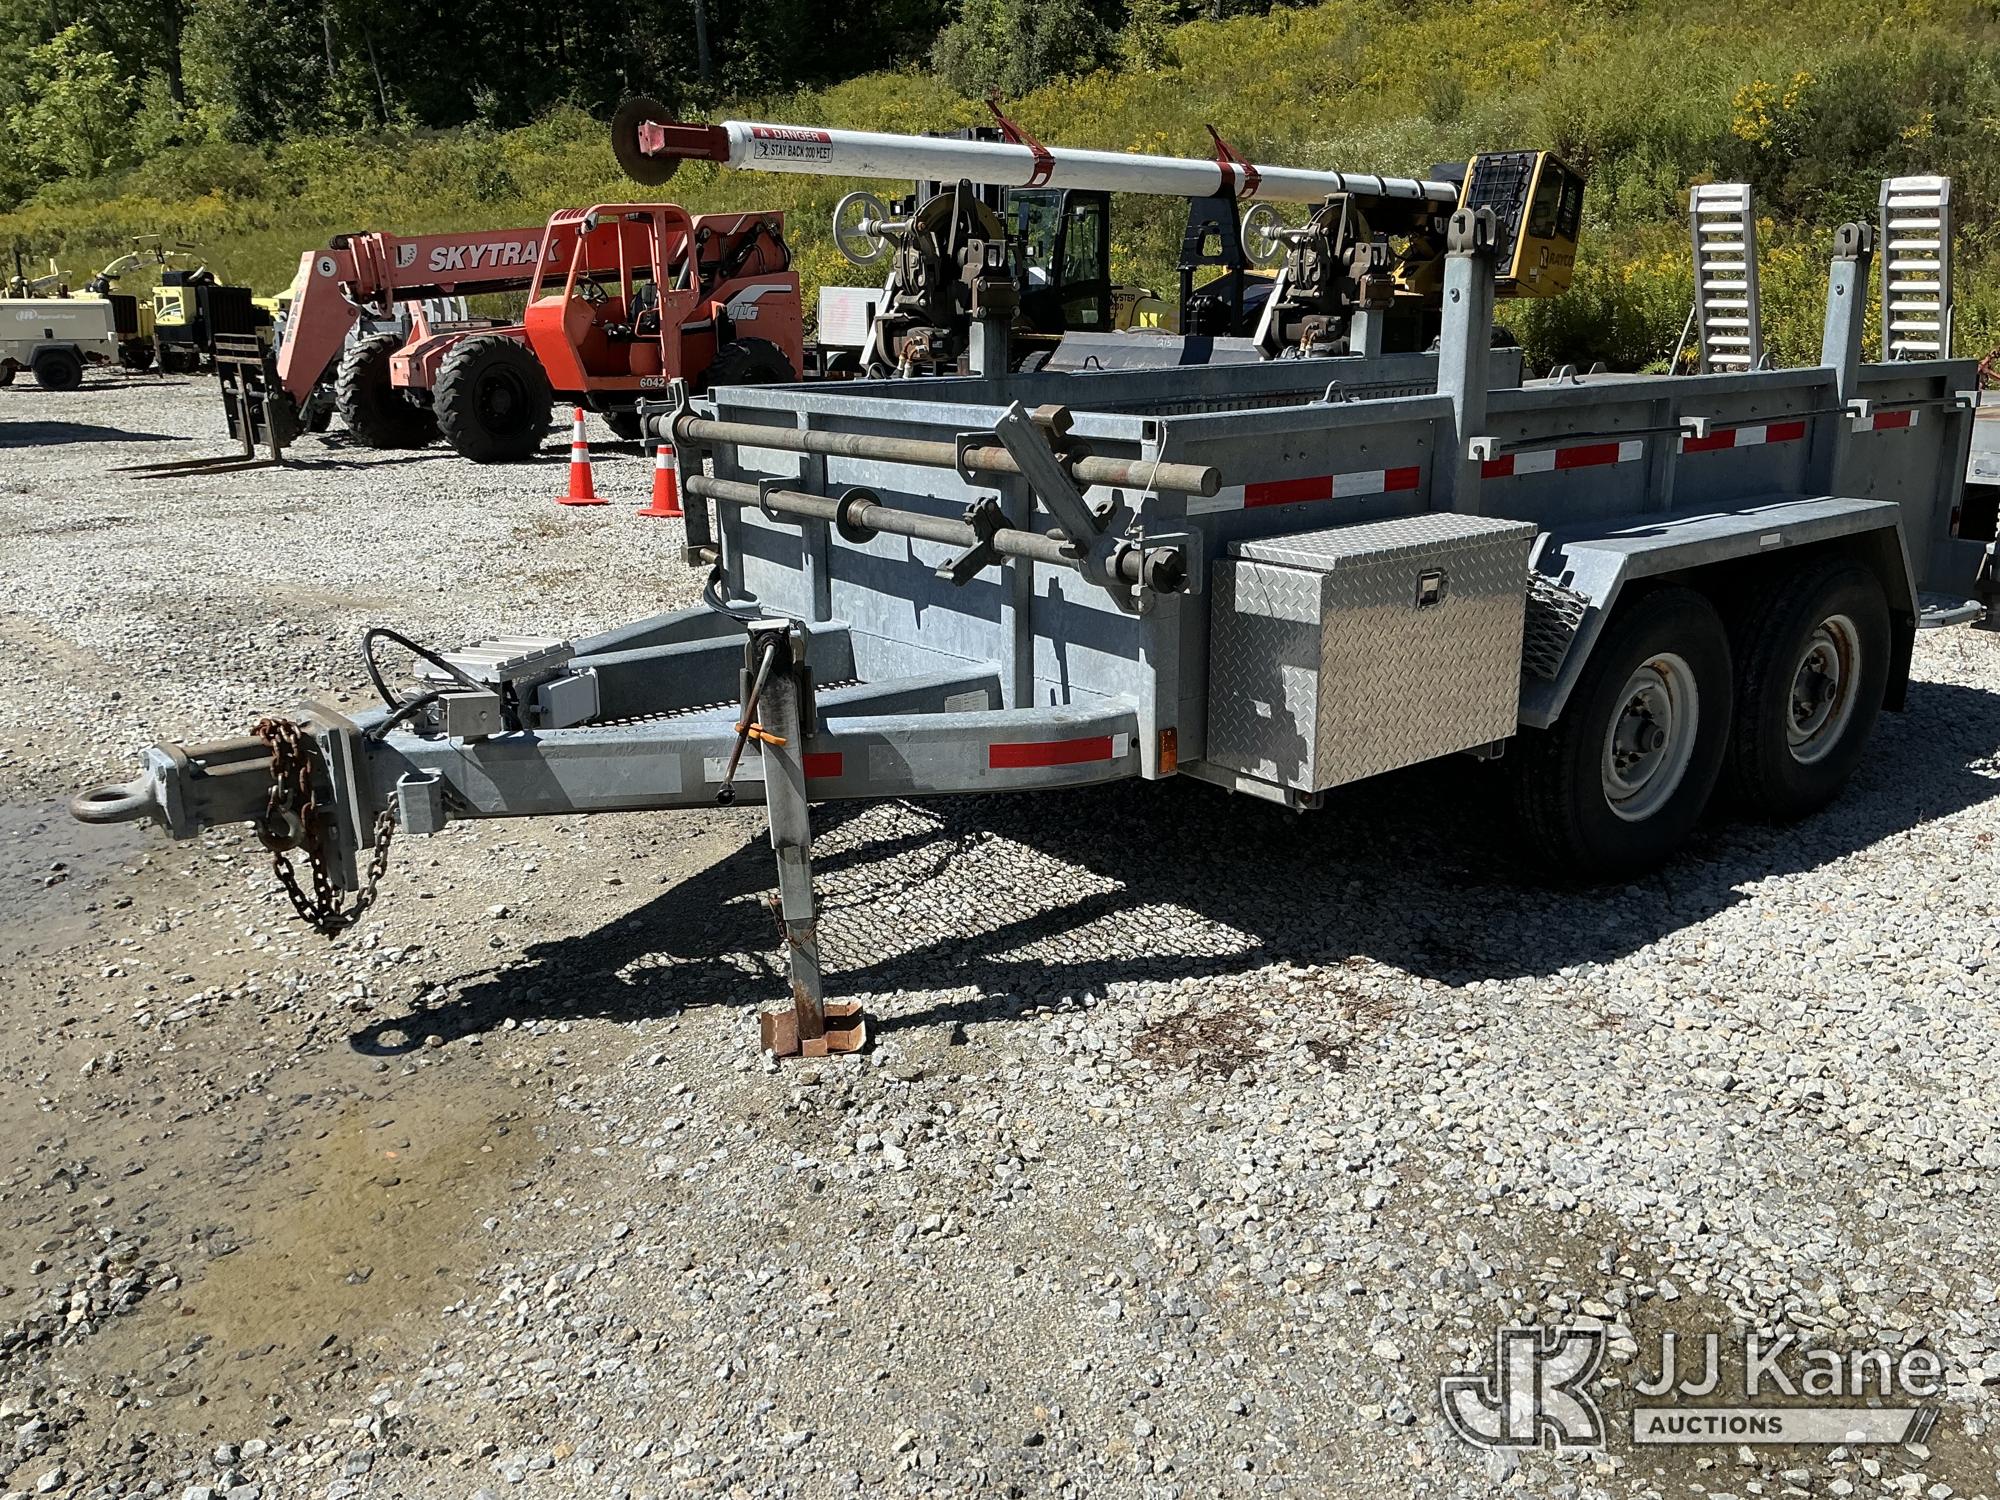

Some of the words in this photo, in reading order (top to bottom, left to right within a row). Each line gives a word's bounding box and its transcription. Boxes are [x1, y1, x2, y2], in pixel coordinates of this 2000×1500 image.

[772, 128, 820, 141] DANGER
[771, 144, 786, 156] STAY
[788, 145, 804, 157] BACK
[323, 261, 331, 272] 6
[728, 303, 759, 320] JLG
[639, 377, 665, 388] 6042
